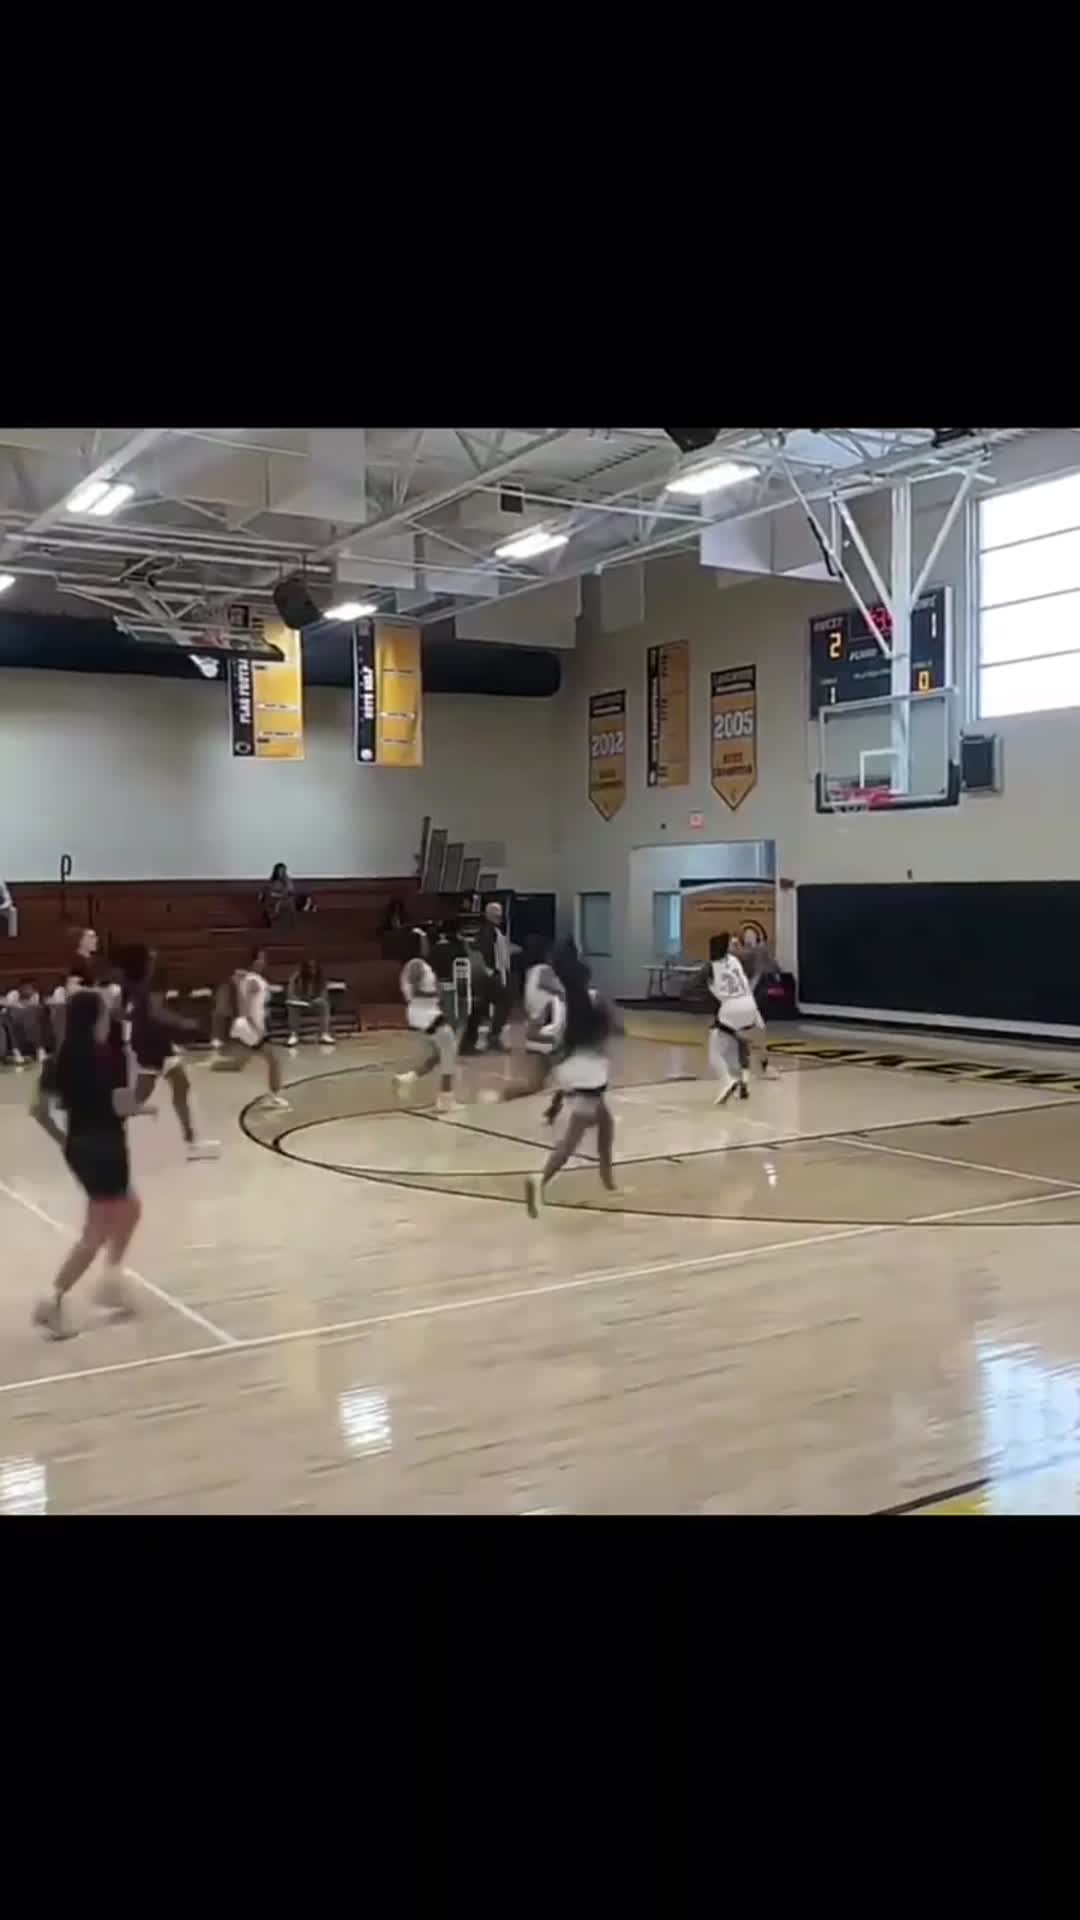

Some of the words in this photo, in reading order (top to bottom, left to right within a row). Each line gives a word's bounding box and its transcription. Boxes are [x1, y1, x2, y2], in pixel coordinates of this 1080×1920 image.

[931, 612, 938, 638] 1
[830, 632, 842, 658] 2
[918, 670, 930, 691] 0
[713, 710, 754, 740] 2005
[765, 1042, 1080, 1089] LAKEW
